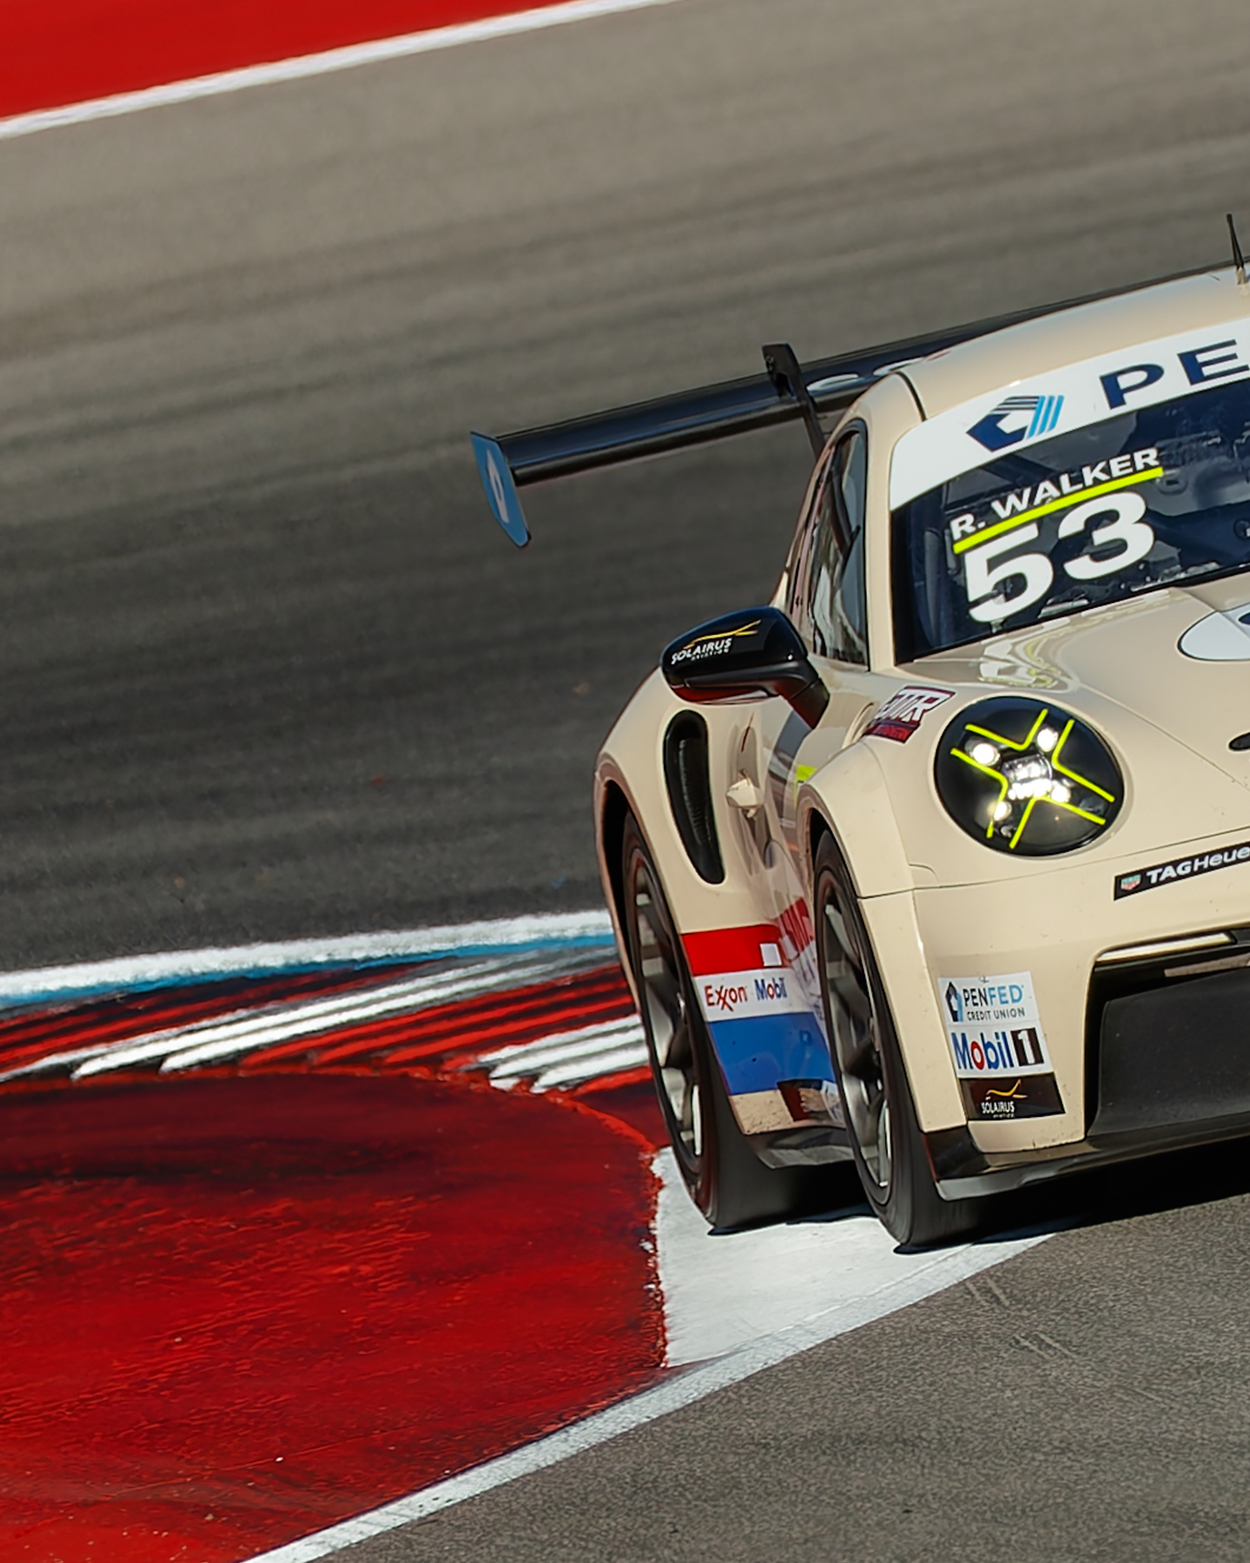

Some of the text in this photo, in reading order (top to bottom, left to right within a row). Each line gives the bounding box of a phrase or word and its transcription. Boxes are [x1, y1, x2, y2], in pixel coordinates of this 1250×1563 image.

[950, 447, 1160, 540] R. WALKER
[964, 491, 1154, 622] 53
[670, 637, 732, 665] SOLAIRUS
[704, 977, 788, 1012] Exxon Mobil
[963, 984, 1023, 1007] PENFED
[967, 1007, 1026, 1021] CREDIT UNION
[951, 1031, 1015, 1070] Mobil
[981, 1101, 1015, 1114] SOLAIRUS
